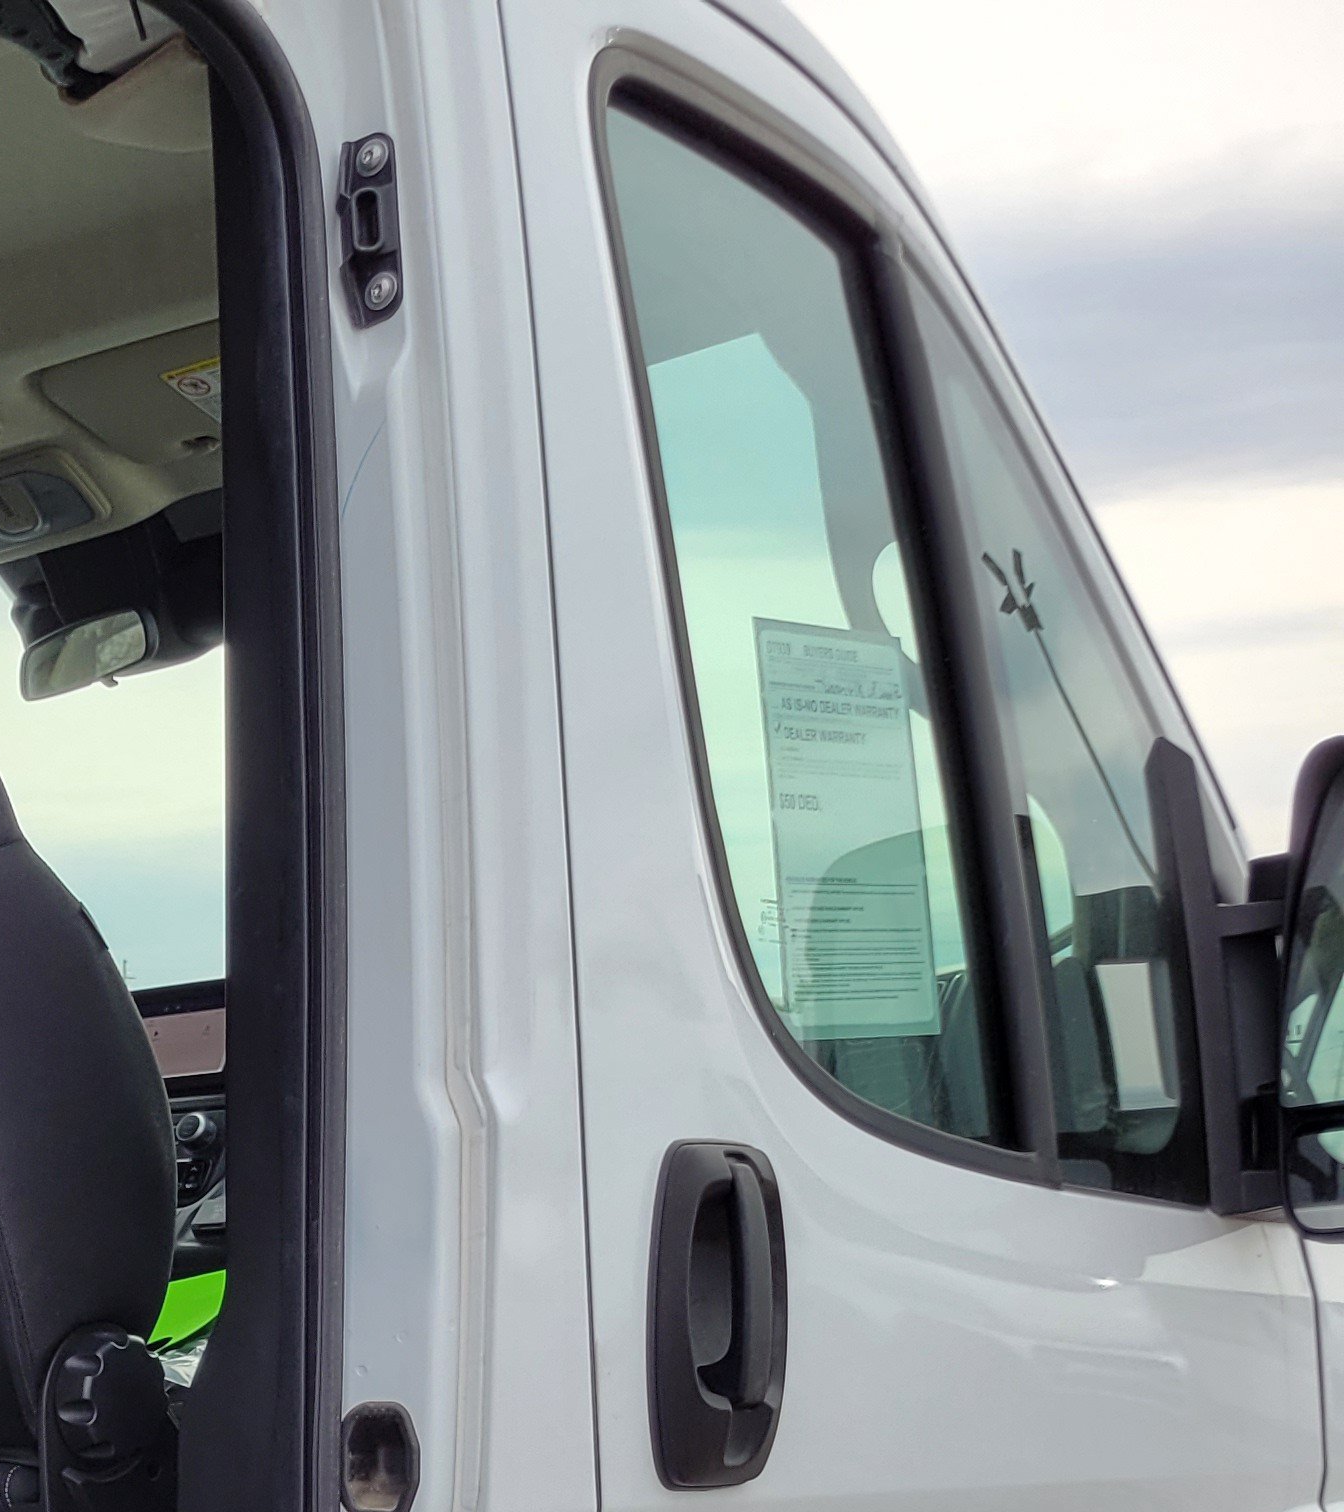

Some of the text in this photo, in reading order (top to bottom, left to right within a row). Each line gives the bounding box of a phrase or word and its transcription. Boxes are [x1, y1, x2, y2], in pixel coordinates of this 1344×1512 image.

[819, 700, 852, 716] DEALER
[854, 704, 900, 720] WARRANTY
[784, 726, 868, 745] DEALER WARRANTY
